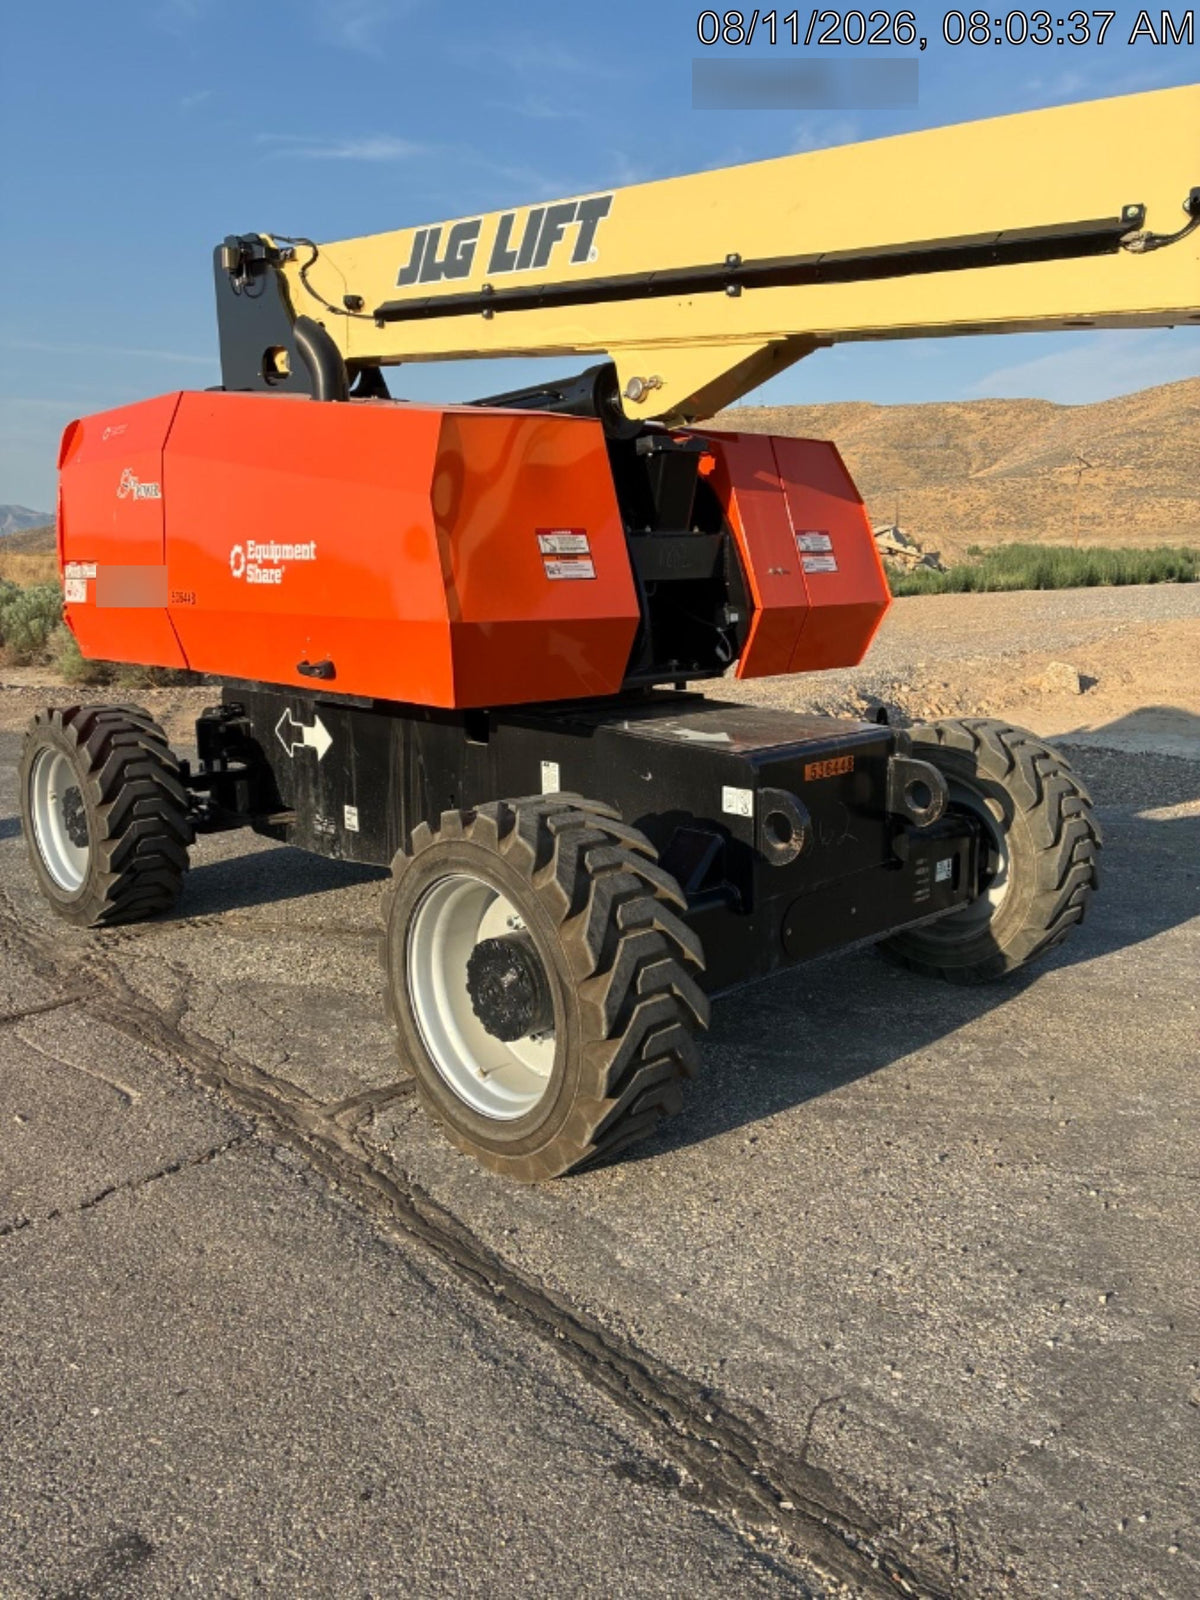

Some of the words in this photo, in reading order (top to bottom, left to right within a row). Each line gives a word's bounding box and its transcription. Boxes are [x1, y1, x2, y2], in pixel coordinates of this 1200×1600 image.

[396, 216, 484, 287] JLG
[487, 193, 614, 275] LIFT
[246, 540, 317, 564] Equipment
[246, 563, 282, 584] Share
